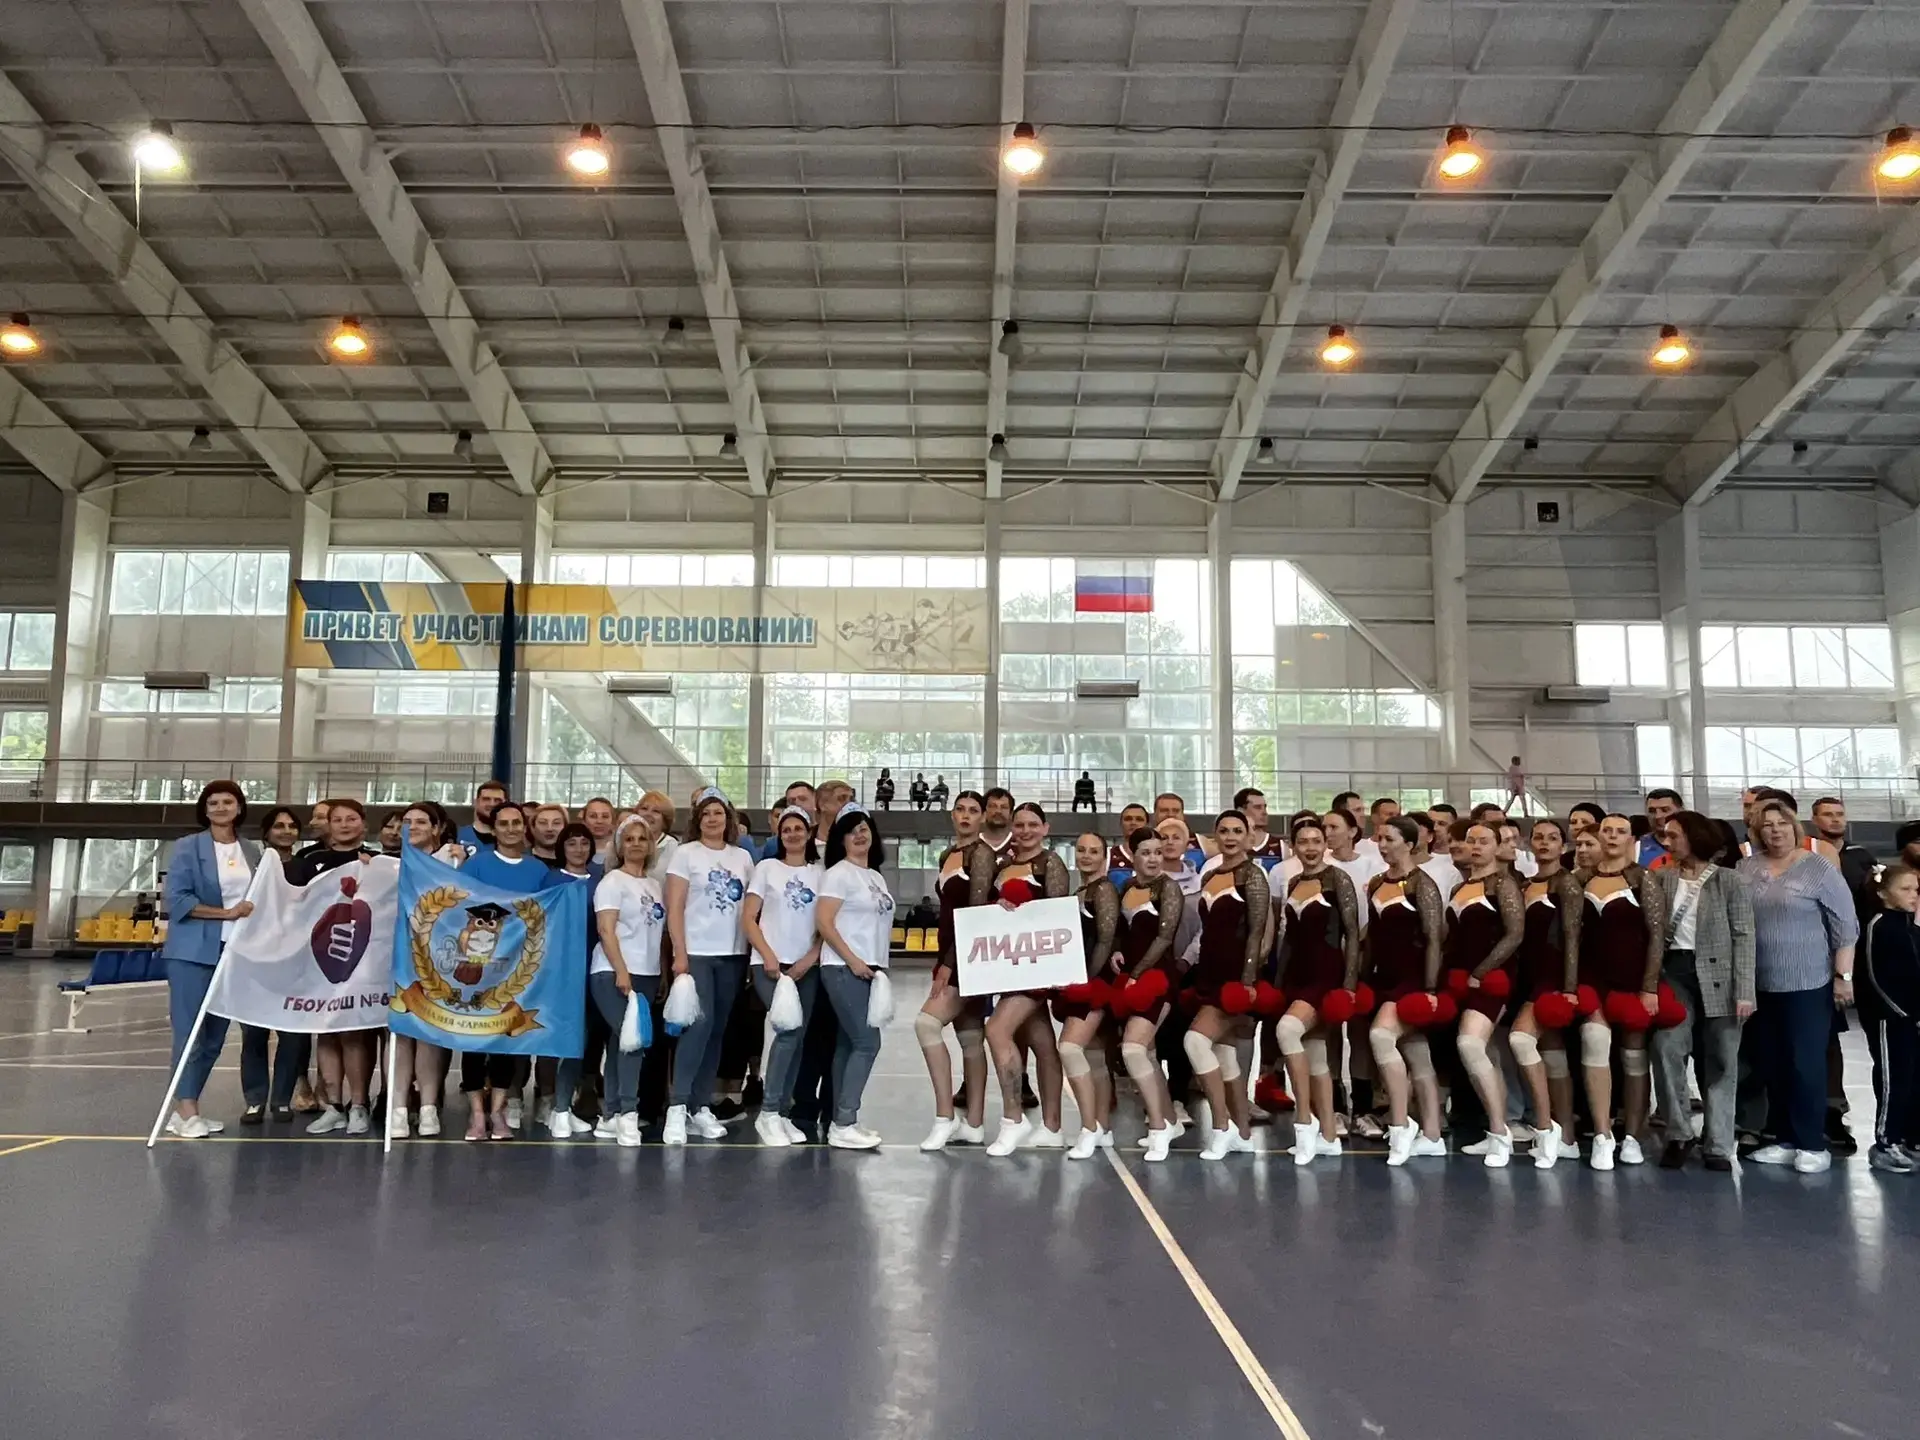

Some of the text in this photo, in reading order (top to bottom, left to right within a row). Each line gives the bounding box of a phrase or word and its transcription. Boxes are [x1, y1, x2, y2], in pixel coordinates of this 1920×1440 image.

[303, 611, 401, 641] ПРИВЕТ
[598, 612, 816, 645] СОРЕВНОВАНИЙ!
[967, 928, 1072, 965] ЛИДЕР
[283, 997, 325, 1012] ГБОУ
